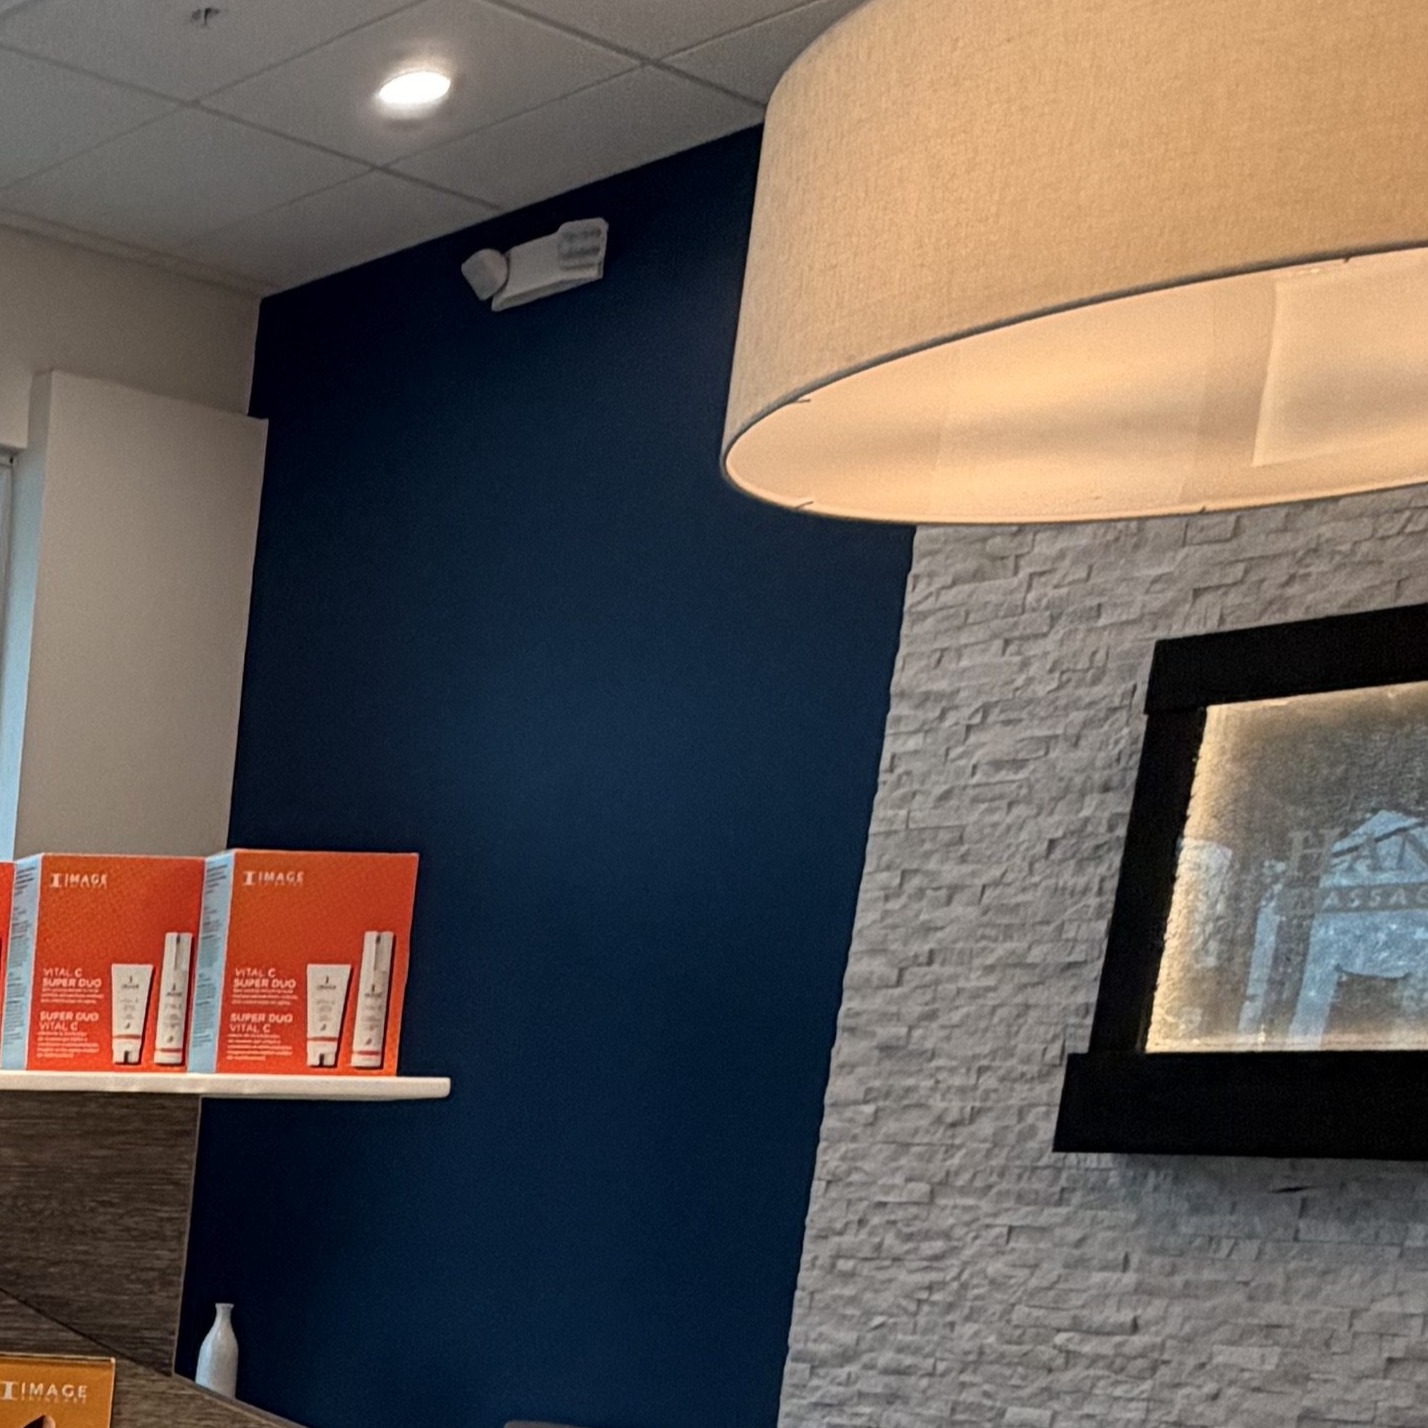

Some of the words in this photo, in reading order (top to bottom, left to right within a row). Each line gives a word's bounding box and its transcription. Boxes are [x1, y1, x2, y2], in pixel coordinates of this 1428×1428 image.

[65, 873, 108, 885] IMAGE
[258, 871, 305, 883] IMAGE
[42, 978, 76, 988] SUPER
[78, 978, 102, 988] DUO
[233, 978, 269, 989] SUPER
[271, 979, 297, 989] DUO
[20, 1382, 88, 1401] IMAGE
